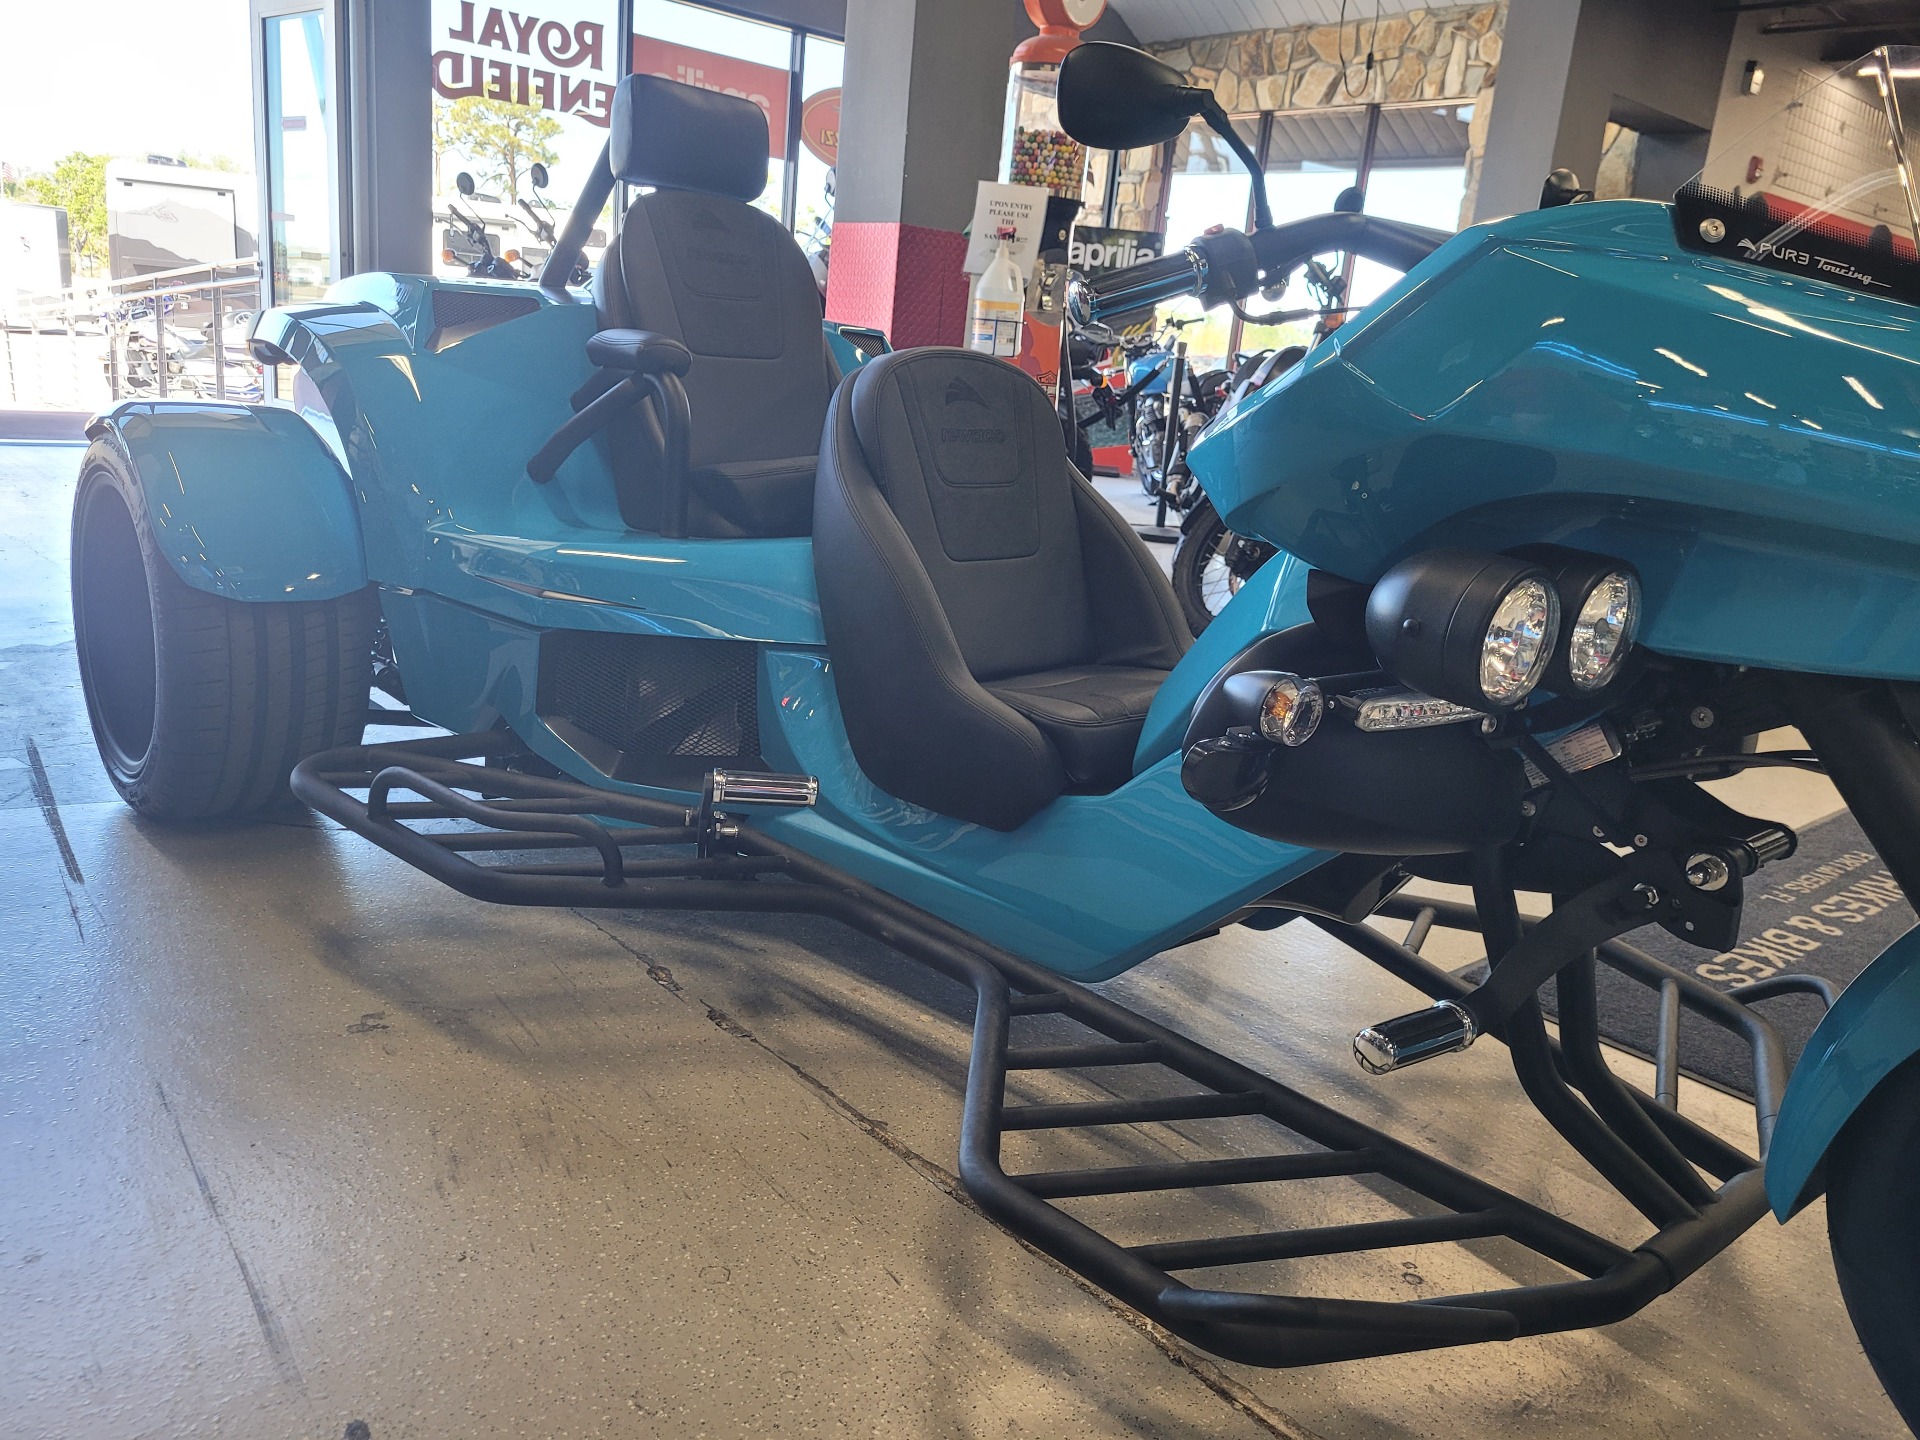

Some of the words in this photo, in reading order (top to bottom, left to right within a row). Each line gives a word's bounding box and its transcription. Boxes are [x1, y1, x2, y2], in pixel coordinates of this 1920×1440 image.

[989, 209, 1015, 217] PLEASE
[1017, 211, 1030, 219] USE
[990, 200, 1009, 208] UPON
[1010, 202, 1033, 211] ENTRY
[1070, 238, 1155, 271] aprilia
[1814, 255, 1892, 286] Touring
[1827, 850, 1876, 871] FORT
[1759, 890, 1797, 904] FL
[1783, 915, 1844, 937] &
[1695, 927, 1822, 988] BIKES
